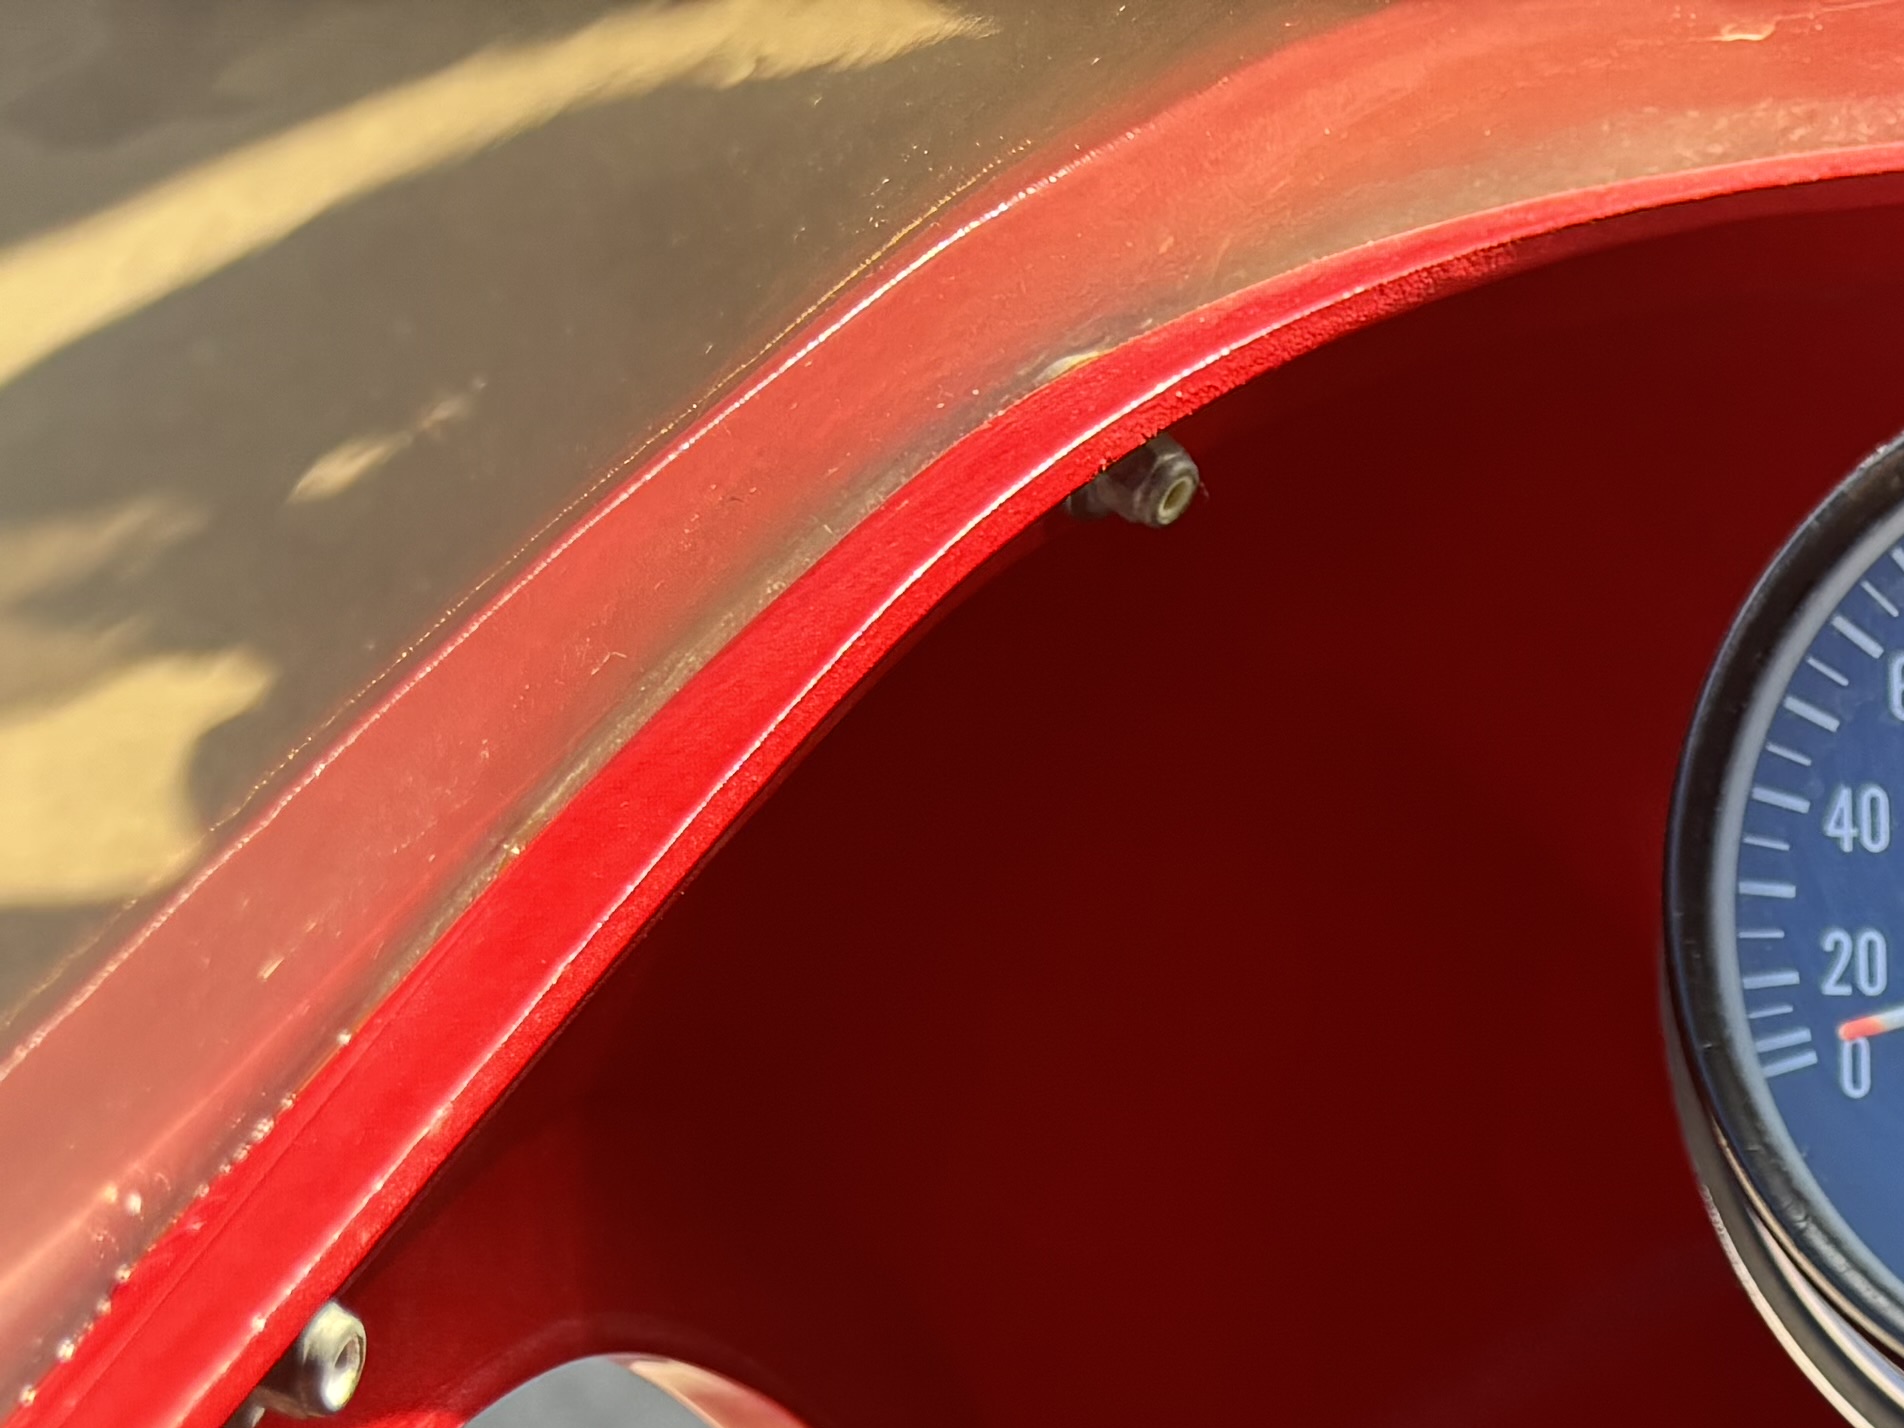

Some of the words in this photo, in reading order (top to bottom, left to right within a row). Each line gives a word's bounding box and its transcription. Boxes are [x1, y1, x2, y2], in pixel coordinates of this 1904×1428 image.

[1823, 784, 1890, 853] 40
[1821, 928, 1887, 997] 20
[1840, 1035, 1871, 1099] 0
